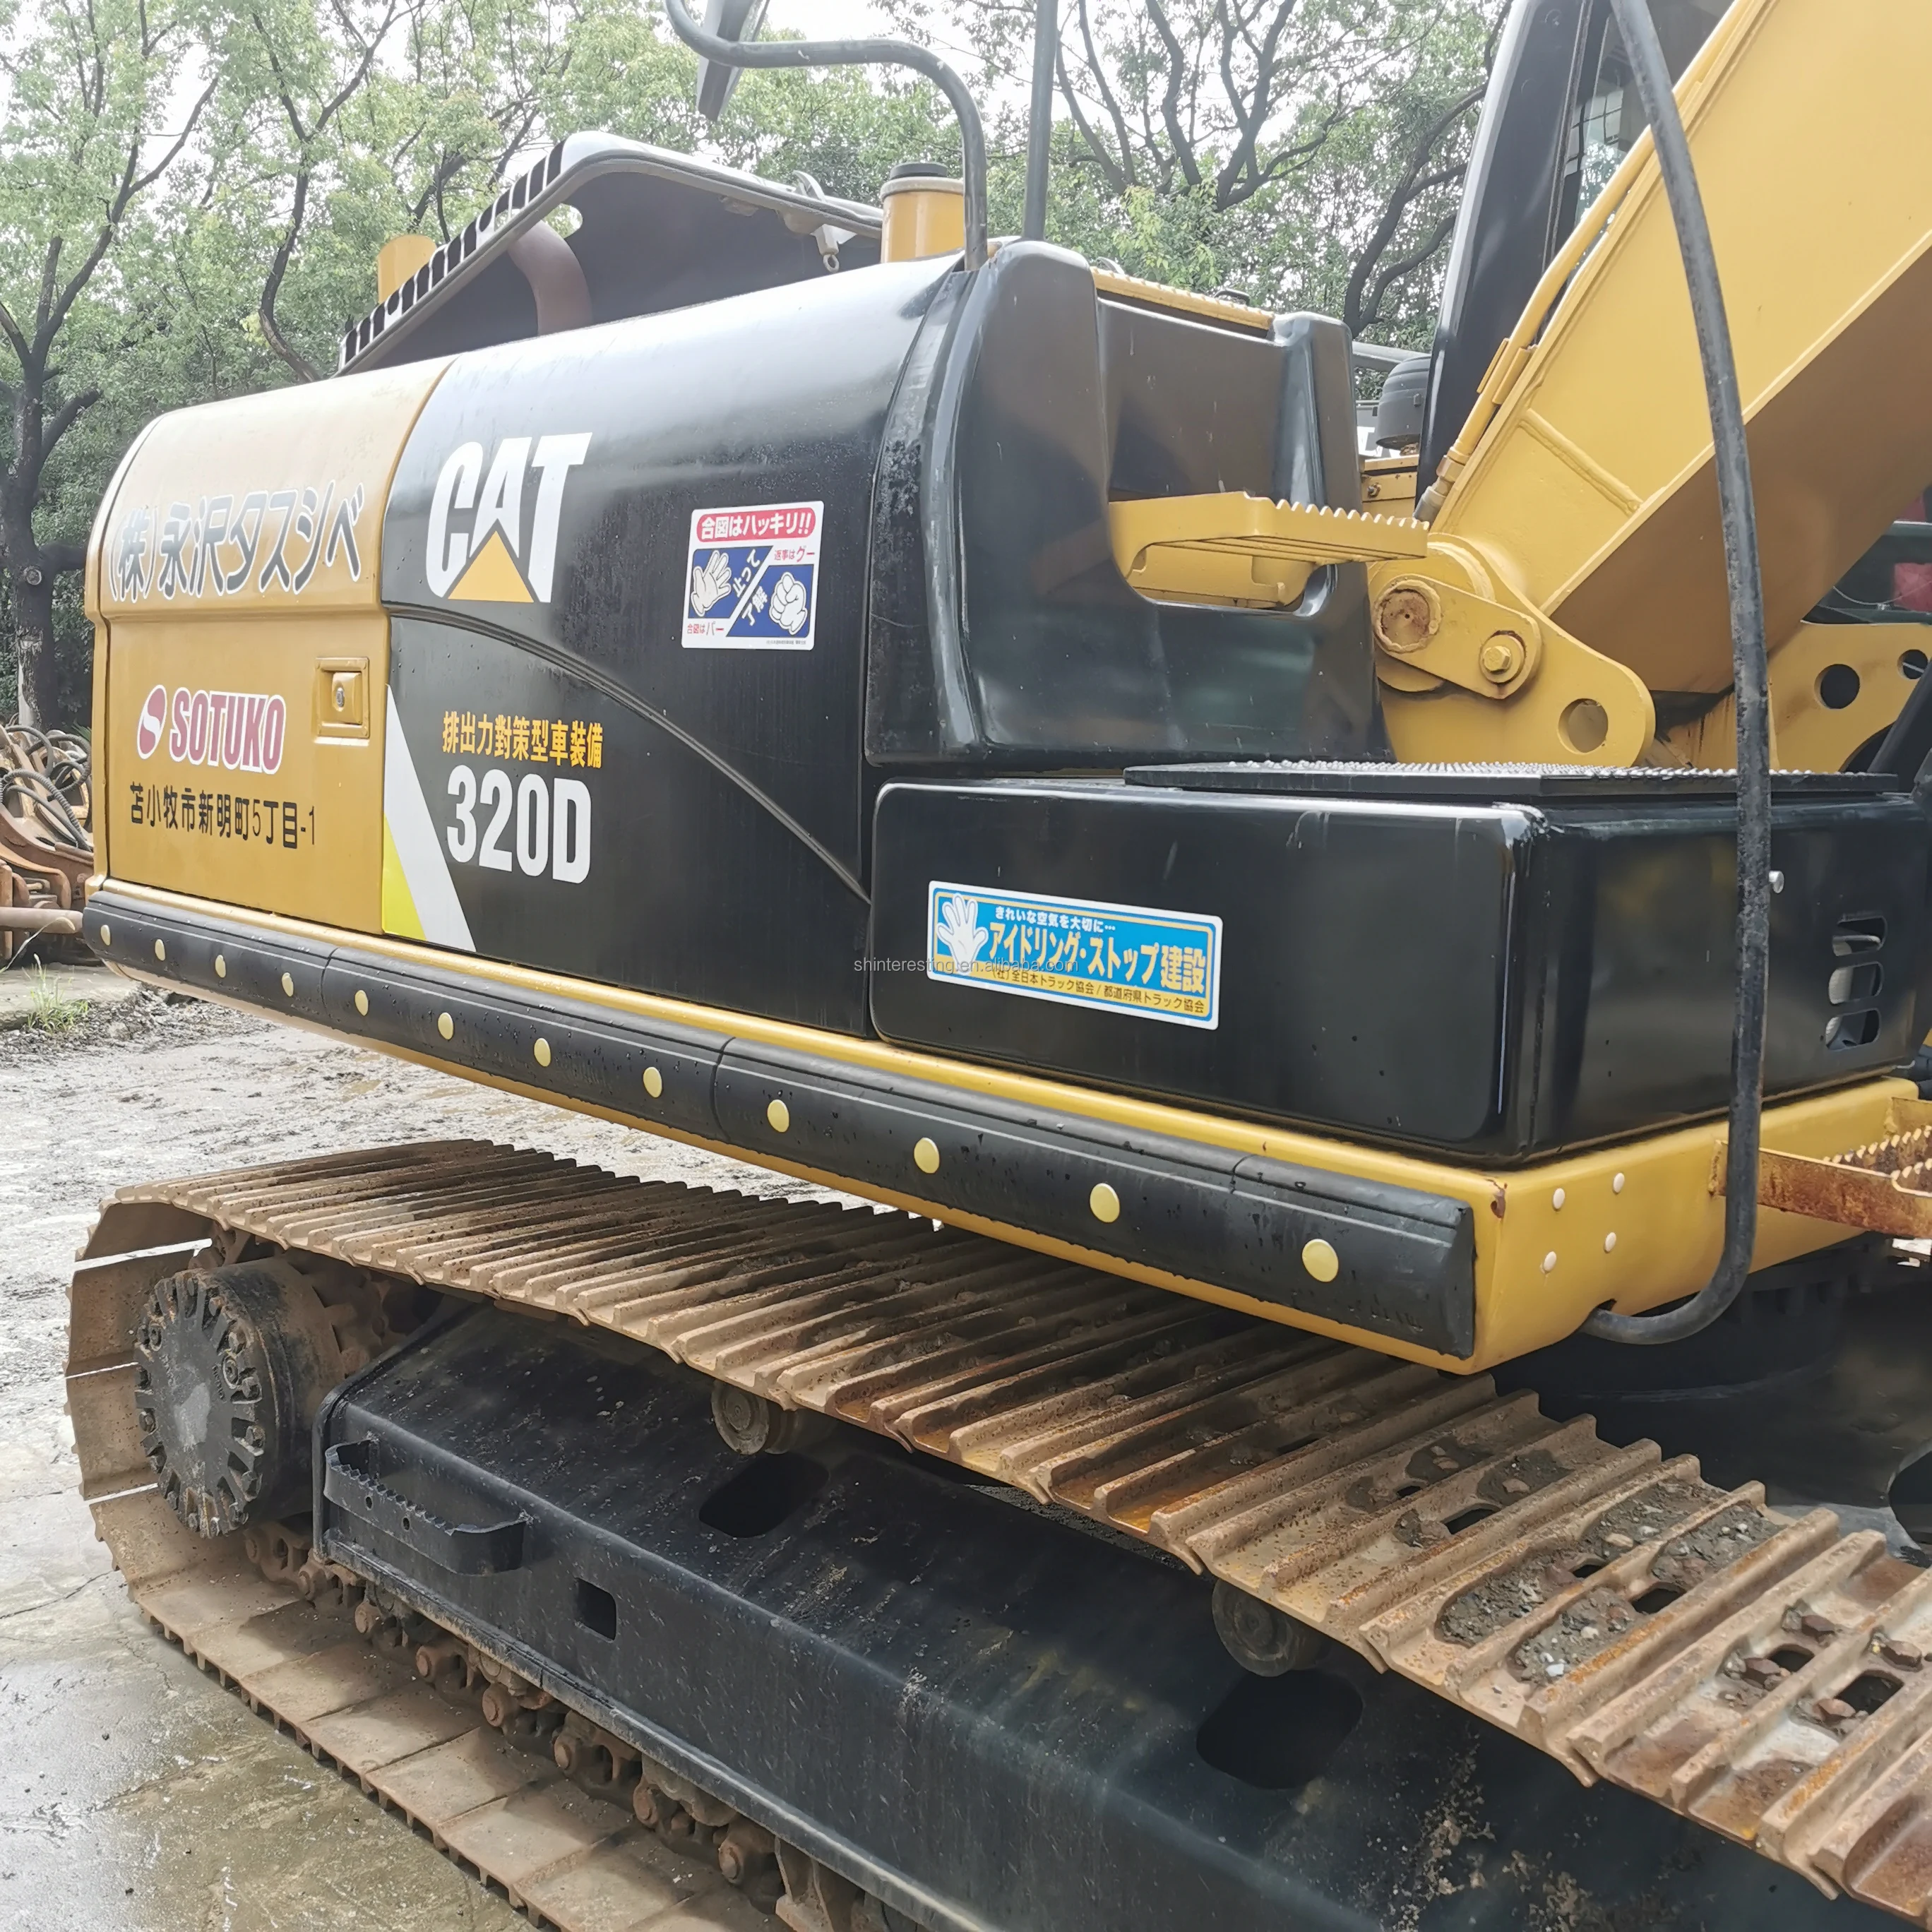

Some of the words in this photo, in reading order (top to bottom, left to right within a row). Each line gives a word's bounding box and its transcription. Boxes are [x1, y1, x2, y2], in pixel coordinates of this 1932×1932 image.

[426, 432, 592, 603] CAT
[701, 513, 811, 539] 合図はハッキリ!!
[687, 621, 724, 636] 合図はパー
[169, 687, 286, 775] SOTUKO
[447, 765, 592, 884] 320D
